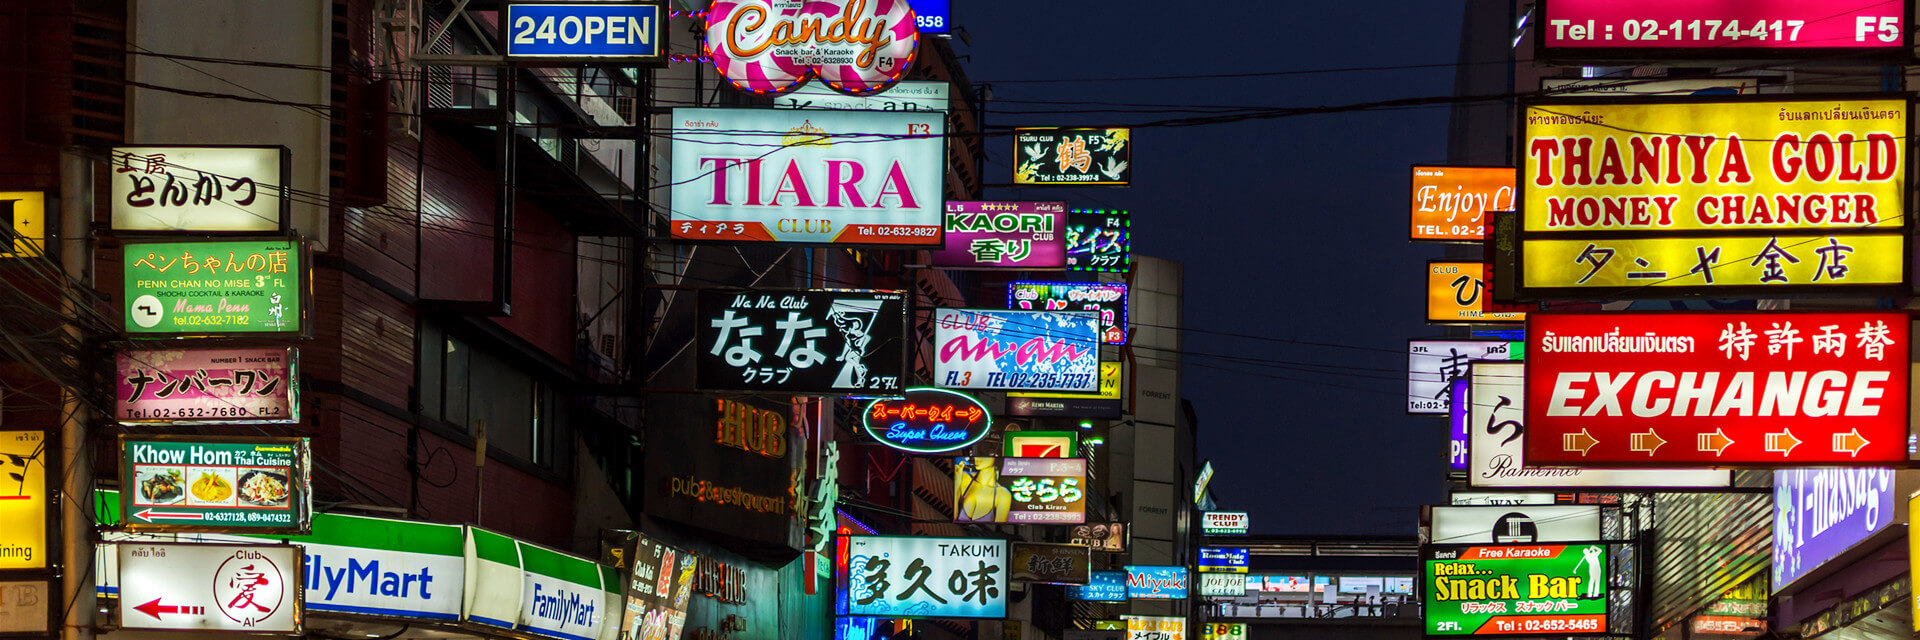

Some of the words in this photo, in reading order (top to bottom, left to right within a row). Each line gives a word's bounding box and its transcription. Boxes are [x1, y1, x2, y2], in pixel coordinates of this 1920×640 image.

[727, 0, 894, 68] Candy
[1551, 19, 1595, 41] Tel
[1623, 19, 1805, 41] 02-1174-417
[1856, 16, 1899, 42] F5
[879, 57, 893, 68] F4
[1778, 104, 1901, 122] รับแลกเปลี่ยนเงินตรา
[907, 124, 930, 139] F3
[1089, 136, 1100, 145] F5
[1055, 135, 1092, 174] 鶴
[1530, 135, 1751, 186] THANIYA
[1772, 132, 1898, 184] GOLD
[117, 153, 166, 174] 工房
[701, 158, 920, 209] TIARA
[1041, 174, 1050, 182] Tel
[126, 171, 256, 207] とんかつ
[1417, 184, 1488, 223] Enjoy
[1547, 196, 1679, 227] MONEY
[1696, 194, 1878, 226] CHANGER
[681, 222, 744, 235] ティアラ
[777, 218, 832, 234] CLUB
[945, 213, 1054, 233] KAORI
[1107, 218, 1120, 228] F4
[1417, 225, 1448, 235] TEL.
[858, 227, 875, 236] Tel.
[878, 227, 937, 237] 02-632-9827
[1032, 233, 1054, 241] CLUB
[968, 238, 1032, 263] 香り
[1575, 232, 1854, 285] タニヤ金店
[133, 251, 287, 274] ペンちゃんの店
[1091, 255, 1120, 266] クラブ
[1432, 266, 1458, 274] CLUB
[137, 280, 167, 288] PENN
[170, 280, 201, 288] CHAN
[204, 280, 221, 288] NO
[224, 280, 250, 288] MISE
[274, 279, 285, 287] FL
[157, 290, 186, 298] SHOCHU
[231, 290, 265, 298] KARAOKE
[732, 295, 752, 309] Na
[755, 295, 776, 309] Na
[780, 295, 808, 309] Club
[1015, 288, 1038, 300] Club
[1068, 290, 1122, 302] ヴァイオリン
[173, 298, 213, 313] Mama
[217, 298, 250, 313] Penn
[173, 315, 249, 326] tel.02-632-7182
[942, 314, 990, 331] CLUB
[710, 310, 827, 369] なな
[1108, 332, 1120, 340] F3
[1541, 326, 1695, 354] รับแลกเปลี่ยนเงินตรา
[238, 356, 242, 364] 1
[267, 356, 280, 364] BAR
[742, 367, 793, 384] クラブ
[945, 371, 972, 387] FL.3
[987, 372, 1006, 387] TEL
[1009, 373, 1090, 389] 02-235-7737
[128, 368, 281, 403] ナンバーワン
[1546, 370, 1891, 417] EXCHANGE
[126, 406, 247, 418] Tel.02-632-7680
[259, 407, 280, 415] FL.2
[872, 403, 983, 422] スーパークイーン
[718, 399, 786, 458] HUB
[886, 422, 925, 443] Super
[929, 424, 968, 441] Queen
[133, 444, 186, 464] Khow
[190, 446, 231, 465] Hom
[234, 456, 254, 465] Thai
[256, 457, 291, 466] Cuisine
[672, 475, 700, 498] pub
[719, 489, 785, 514] restaurant
[247, 513, 291, 523] 089-0474322
[236, 550, 261, 560] Club
[938, 544, 1000, 558] TAKUMI
[1479, 548, 1504, 559] Free
[1506, 547, 1551, 558] Karaoke
[1026, 554, 1073, 576] 新鮮
[1434, 562, 1493, 576] Relax...
[228, 564, 271, 613] 愛
[857, 555, 1000, 606] 多久味
[1128, 571, 1187, 593] Miyuki
[1435, 574, 1524, 602] Snack
[1528, 574, 1582, 600] Bar
[532, 583, 595, 629] FamilyMart
[1461, 601, 1507, 614] リラックス
[1515, 600, 1578, 613] スナックバー
[1497, 620, 1515, 631] Tel
[1525, 619, 1598, 631] 02-652-5465
